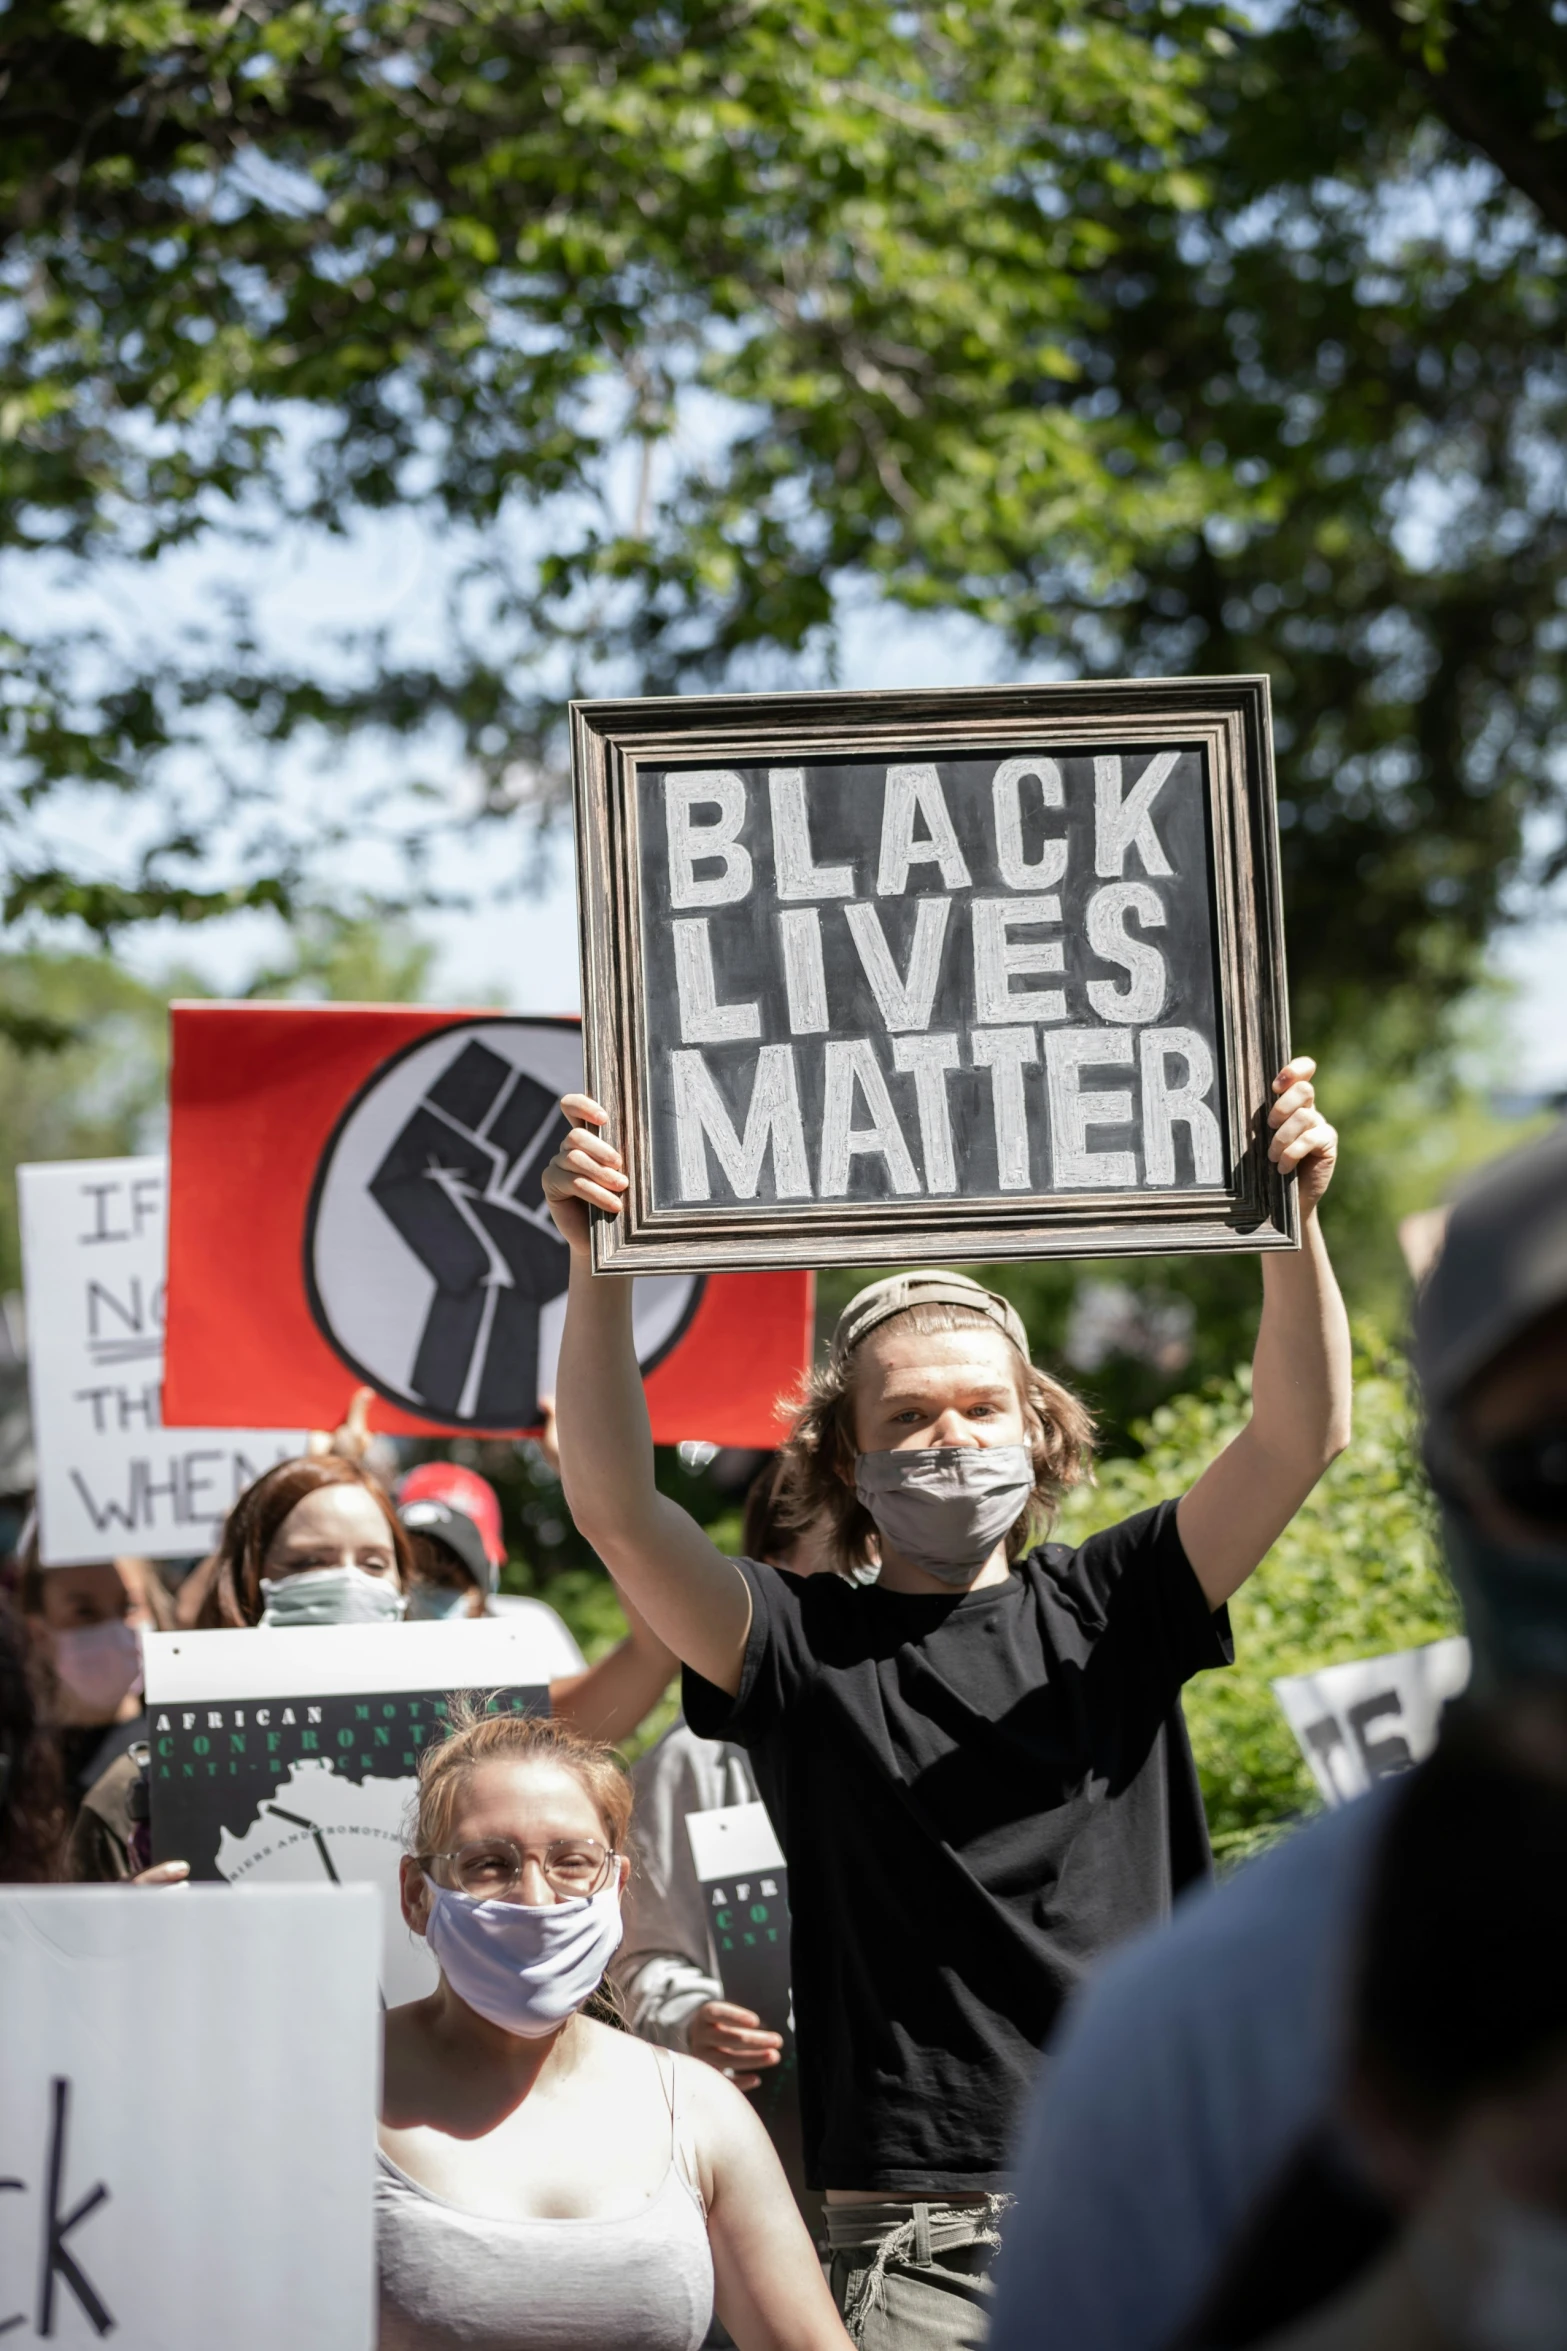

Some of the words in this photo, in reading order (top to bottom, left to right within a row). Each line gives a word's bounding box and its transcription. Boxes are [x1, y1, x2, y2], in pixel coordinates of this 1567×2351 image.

[664, 750, 1183, 909] BLACK
[672, 881, 1167, 1044] LIVES
[671, 1026, 1224, 1201] MATTER
[78, 1179, 161, 1246] IF
[156, 1706, 322, 1732] AFRICAN
